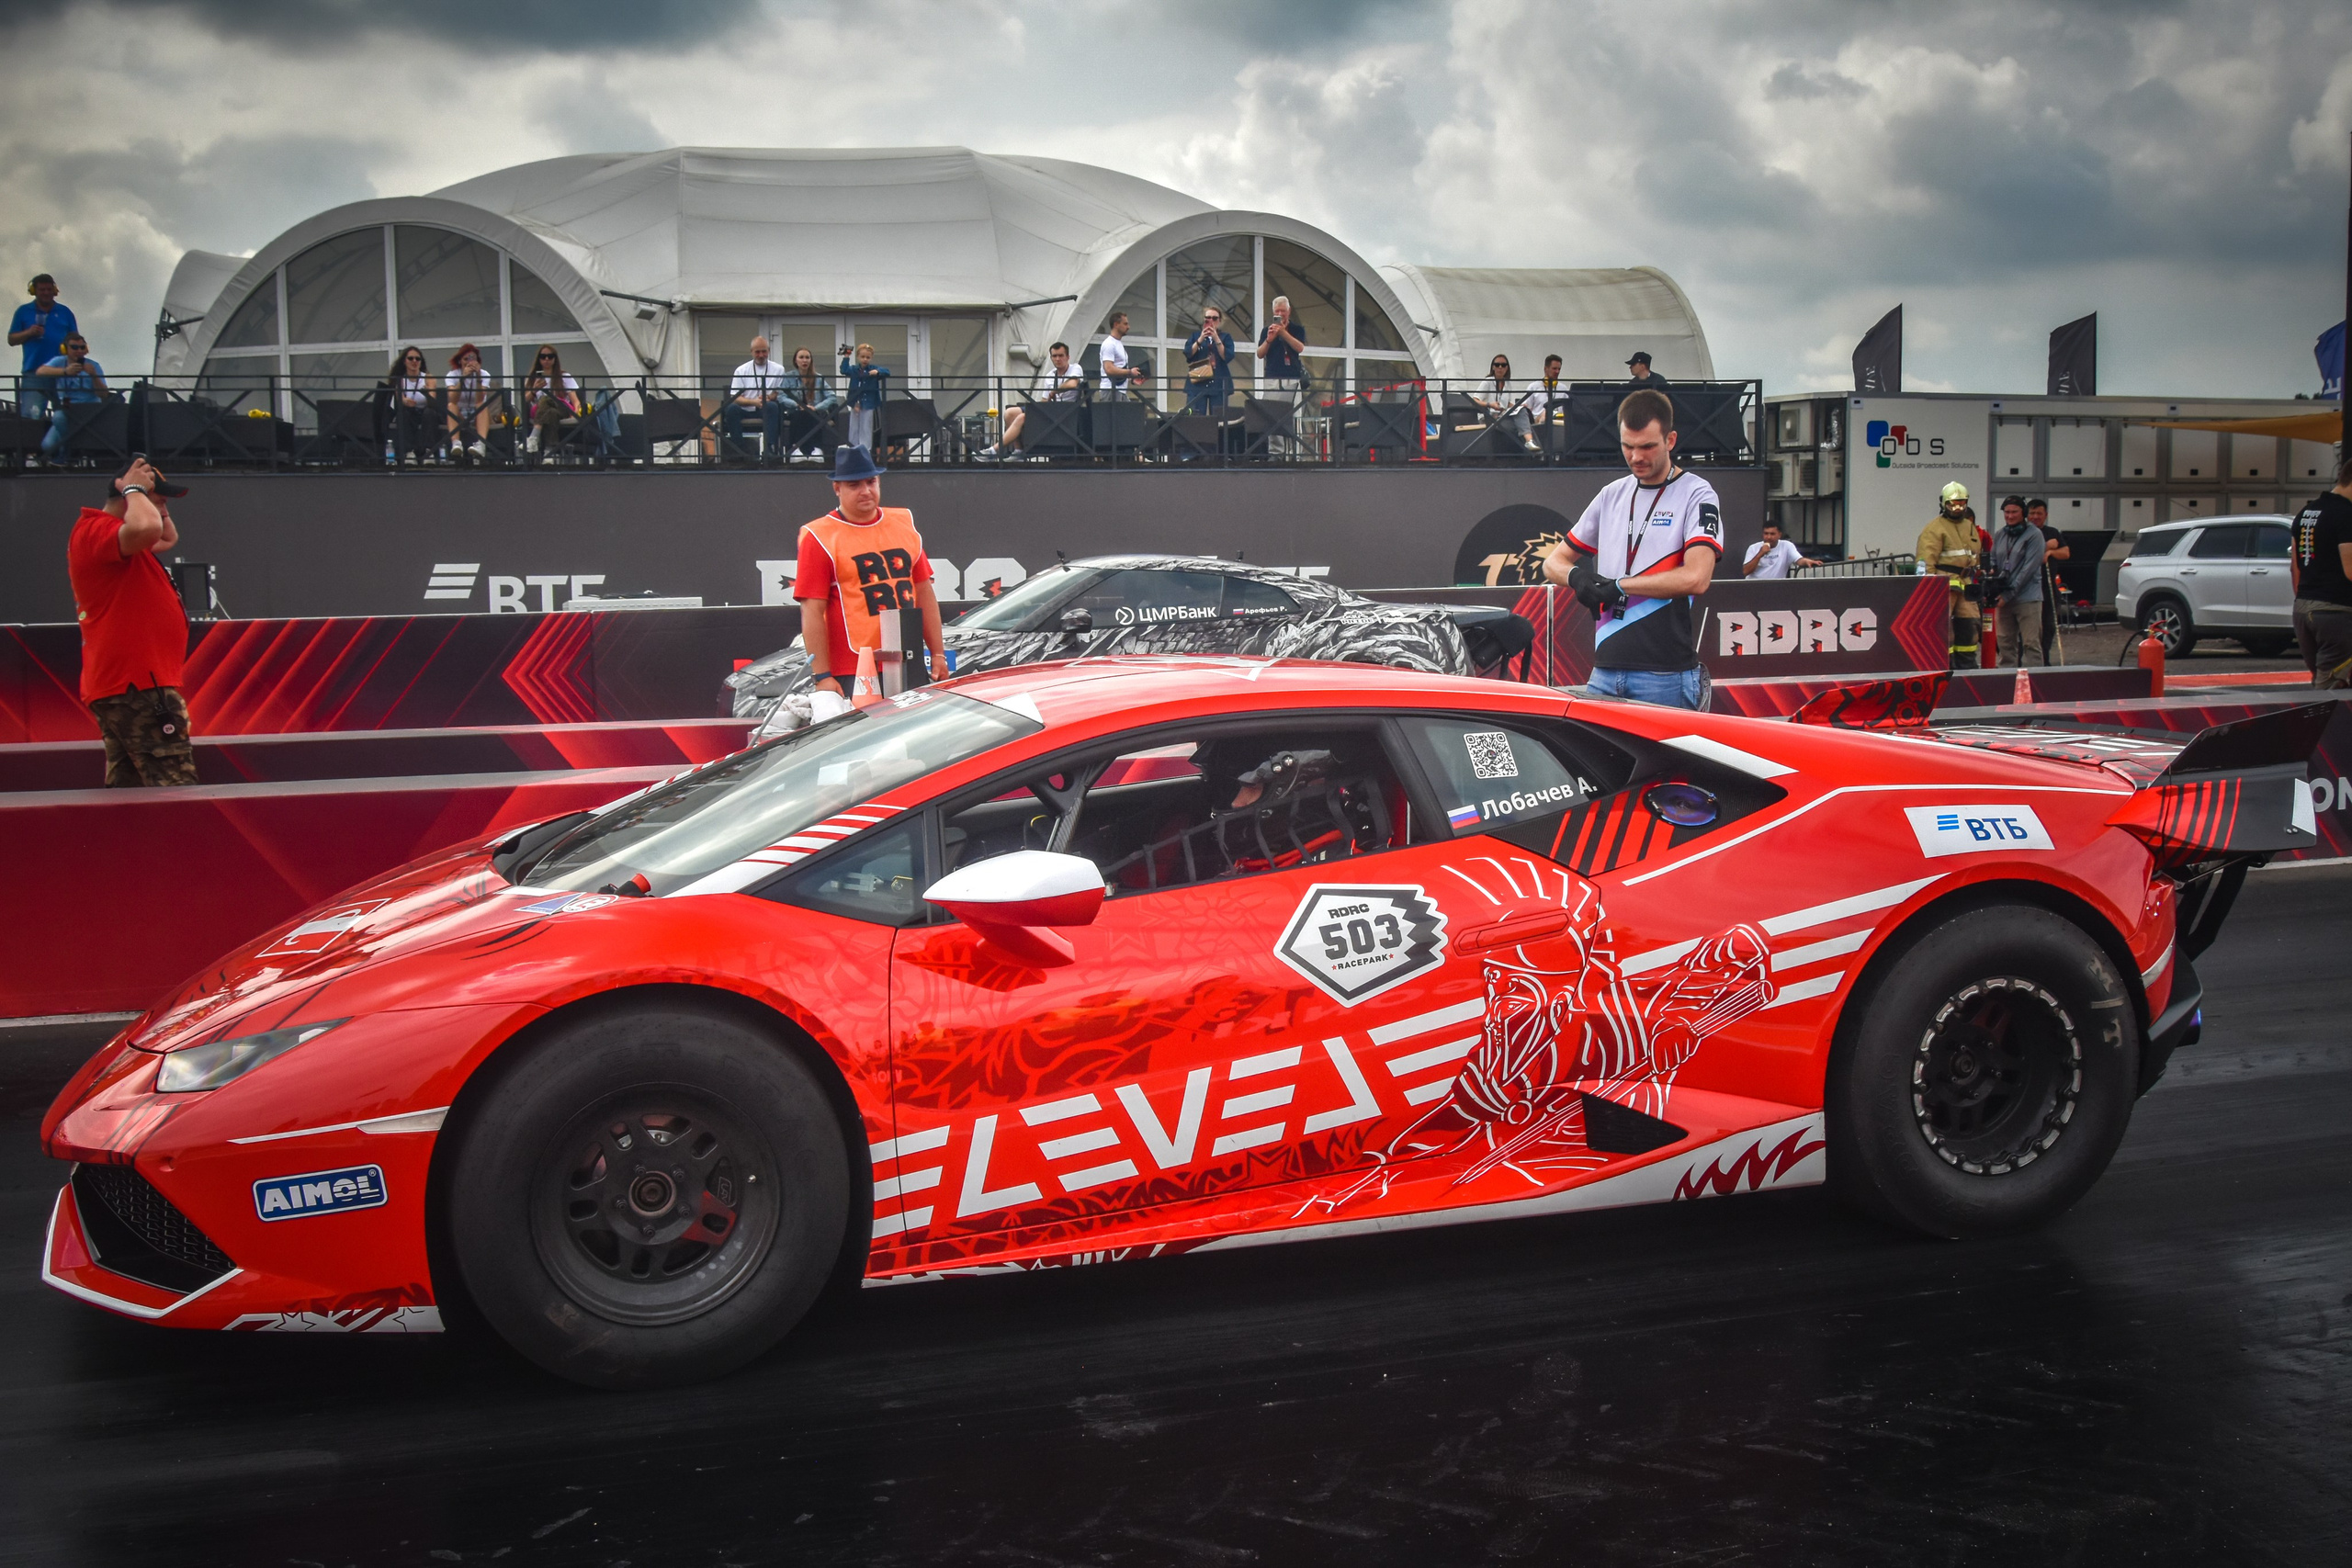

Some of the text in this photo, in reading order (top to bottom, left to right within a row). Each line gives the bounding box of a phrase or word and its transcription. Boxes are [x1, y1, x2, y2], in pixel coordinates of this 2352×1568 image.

[851, 547, 912, 585] RD
[860, 581, 916, 617] RC
[1138, 605, 1217, 623] ЦМРБанк
[1717, 608, 1877, 656] RDRC
[1482, 776, 1598, 820] Лобачев А.
[1964, 818, 2028, 841] ВТБ
[1328, 904, 1370, 919] RDRC
[1318, 913, 1403, 961] 503
[1338, 953, 1388, 970] RACEPARK
